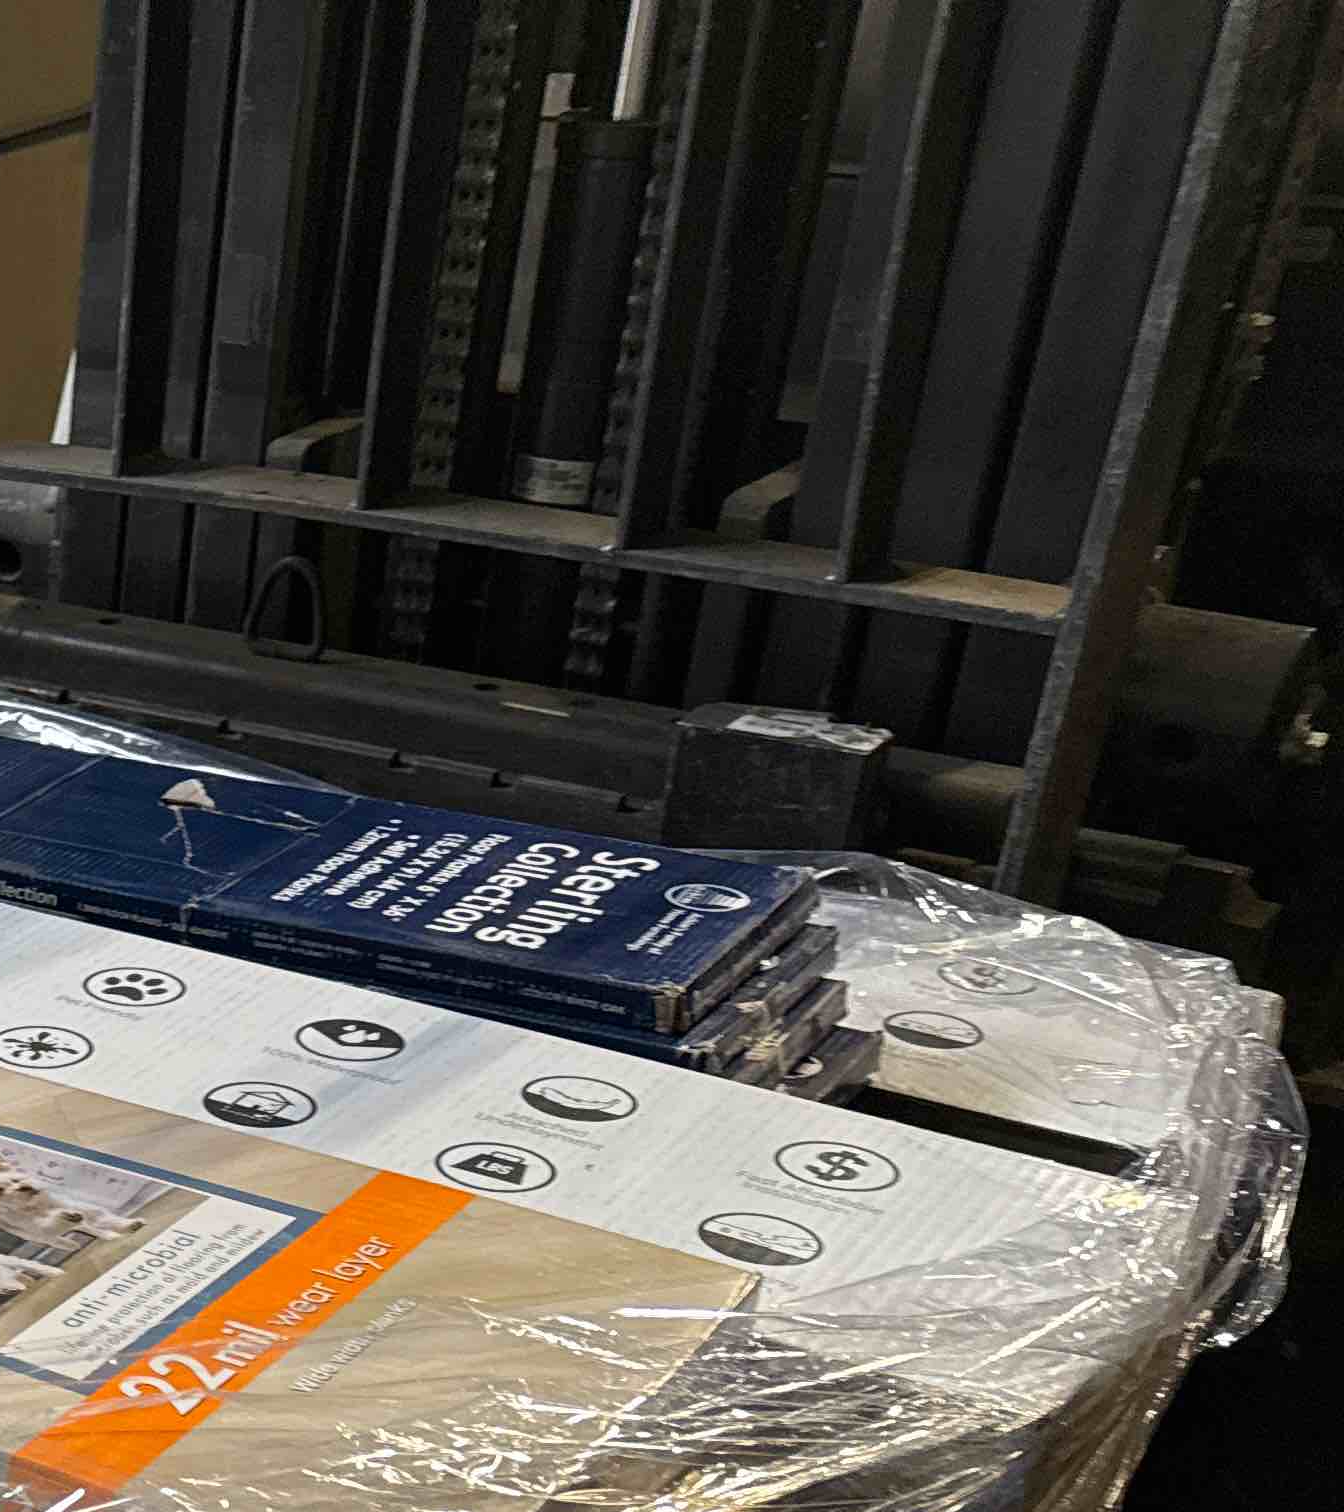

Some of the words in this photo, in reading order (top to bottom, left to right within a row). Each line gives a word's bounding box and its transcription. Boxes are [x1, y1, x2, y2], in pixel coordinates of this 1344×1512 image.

[325, 857, 391, 895] Adhesive
[429, 844, 577, 936] Collection
[469, 834, 511, 854] Floor
[477, 850, 661, 950] Sterling
[63, 1229, 202, 1329] anti-microbial
[267, 1280, 341, 1328] wear
[312, 1236, 397, 1283] layer
